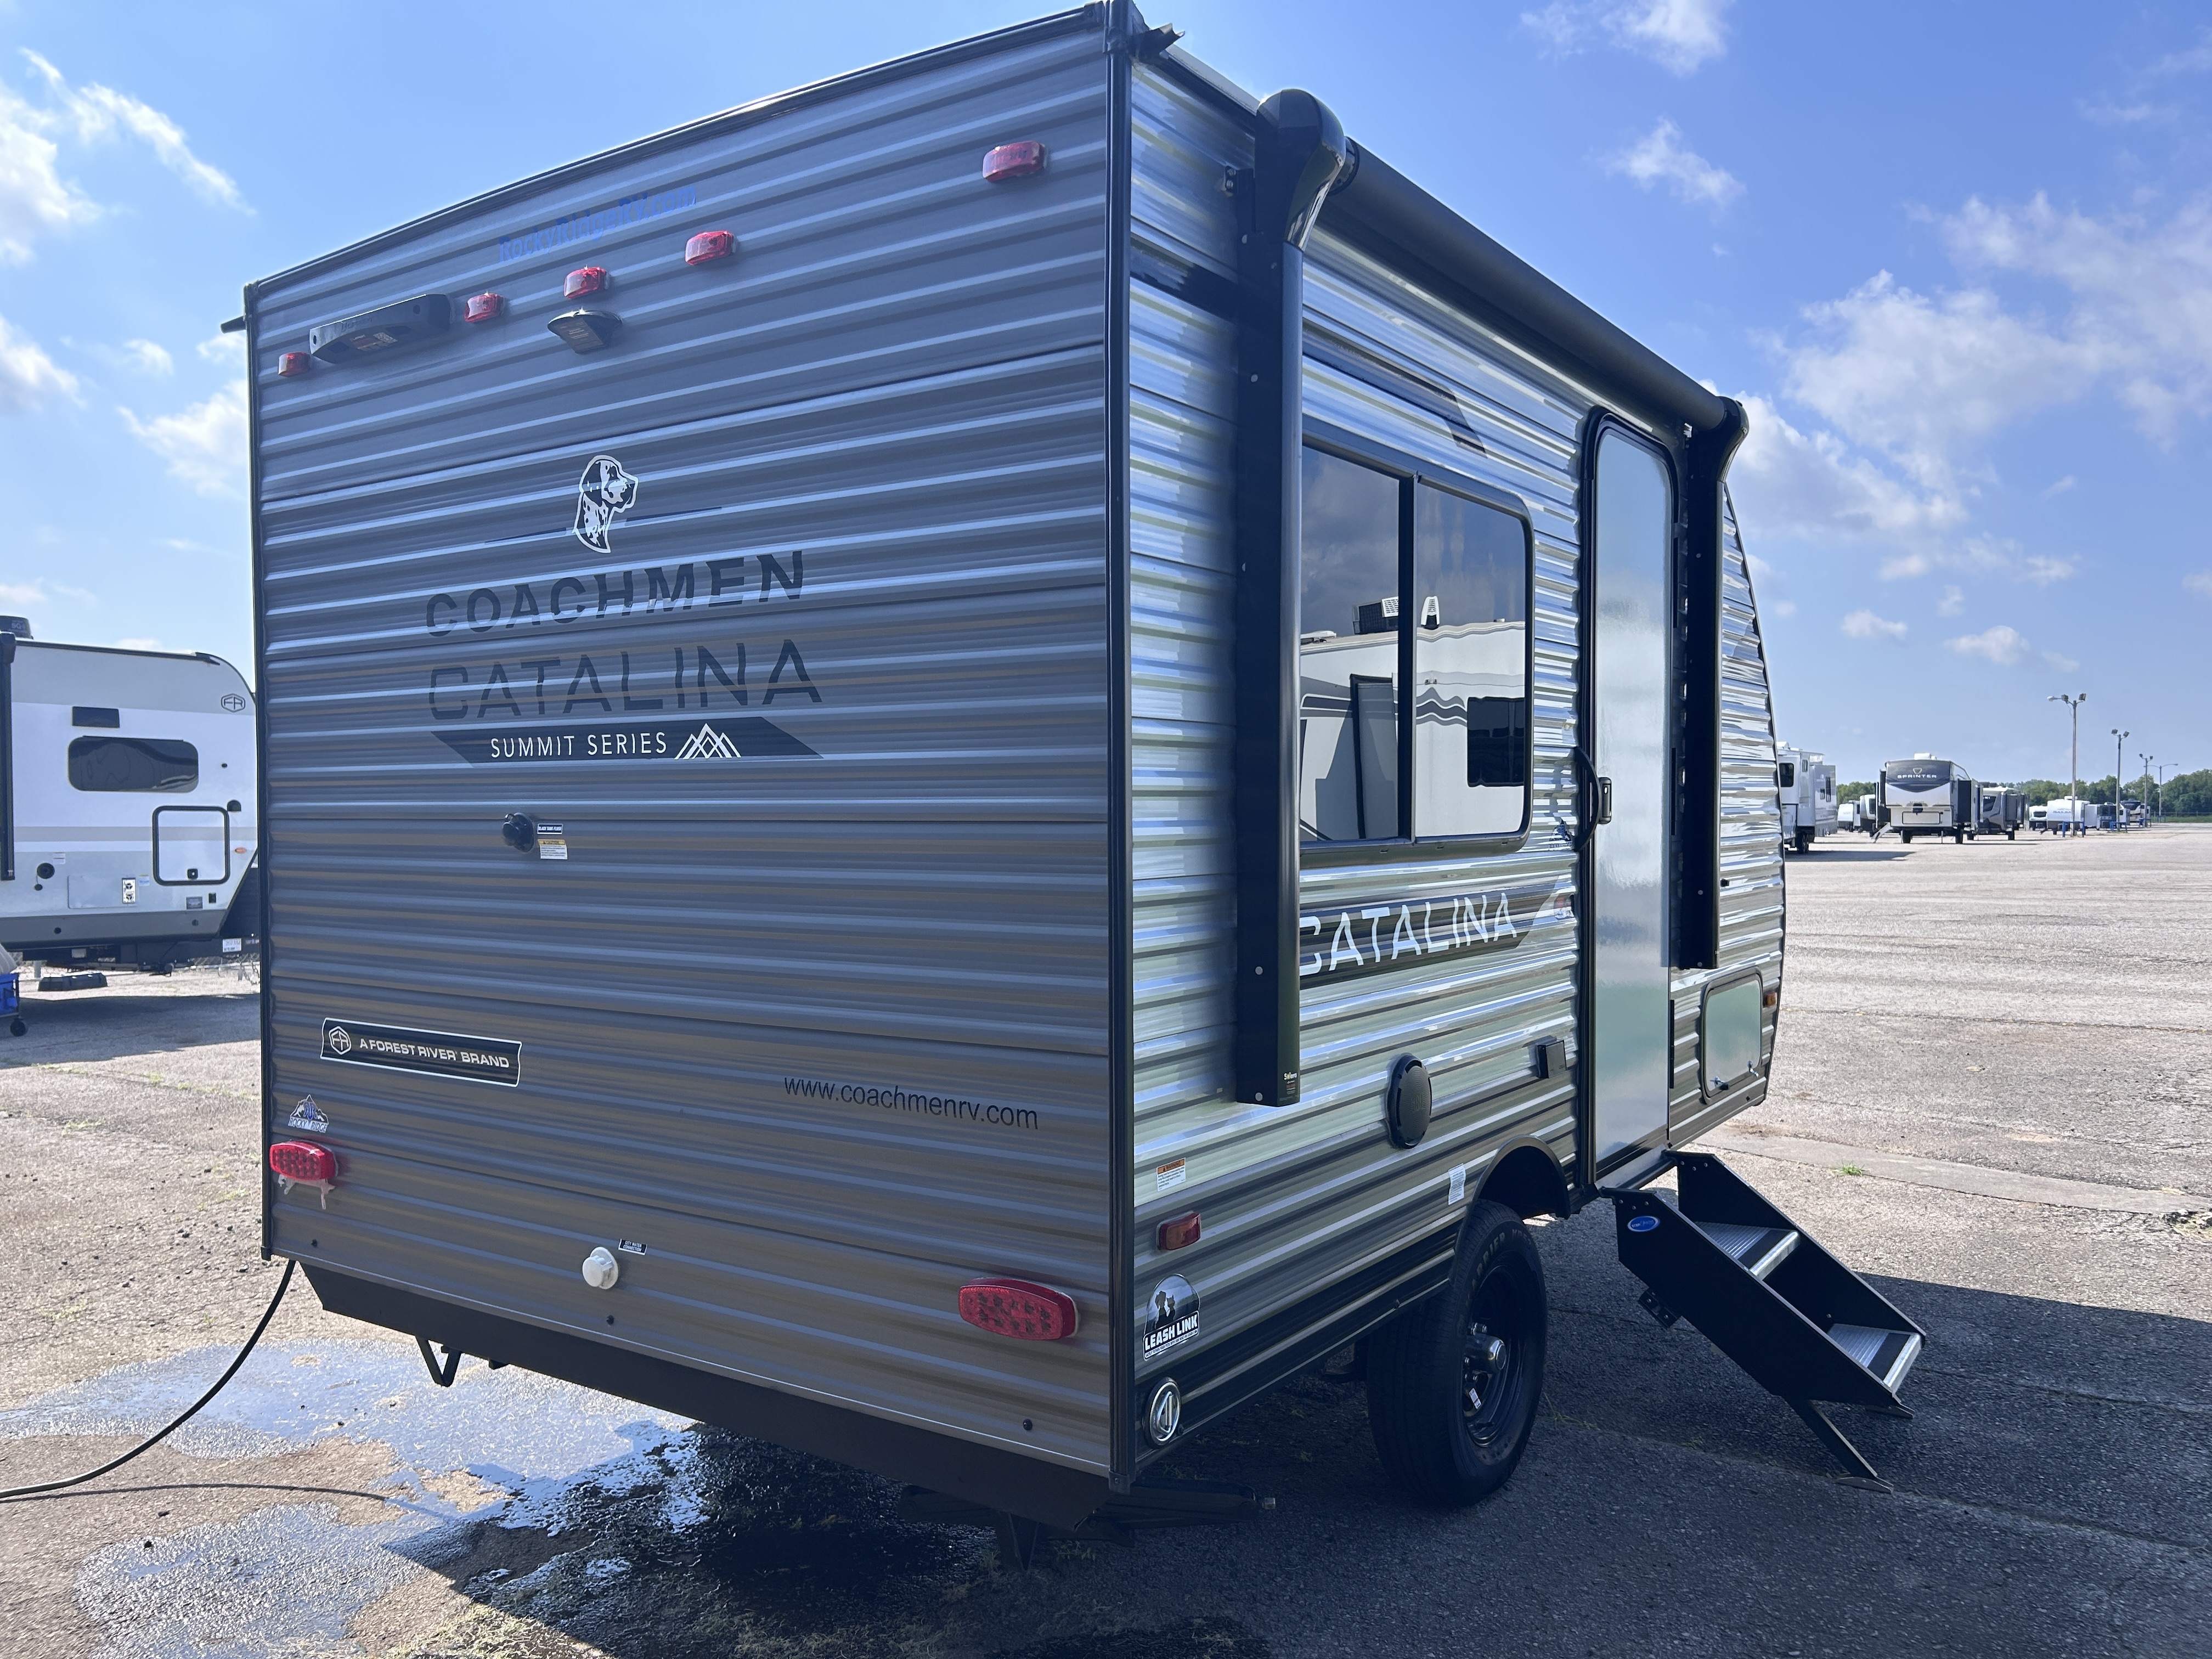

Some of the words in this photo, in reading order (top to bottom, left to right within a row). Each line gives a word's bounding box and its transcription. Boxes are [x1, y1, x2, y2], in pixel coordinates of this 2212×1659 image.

[499, 187, 696, 262] RockyRidgeRV.com
[426, 551, 803, 636] COACHMEN
[428, 639, 822, 720] CATALINA
[490, 735, 575, 758] SUMMIT
[588, 732, 667, 755] SERIES
[1300, 893, 1517, 976] CATALINA
[360, 1039, 369, 1049] A
[369, 1040, 416, 1056] FOREST
[460, 1051, 510, 1069] BRAND
[289, 1117, 307, 1128] ROCKY
[311, 1121, 328, 1132] RIDGE
[784, 1077, 1039, 1130] www.coachmenrv.com
[1144, 1325, 1175, 1351] LEASH
[1177, 1314, 1198, 1336] LINK
